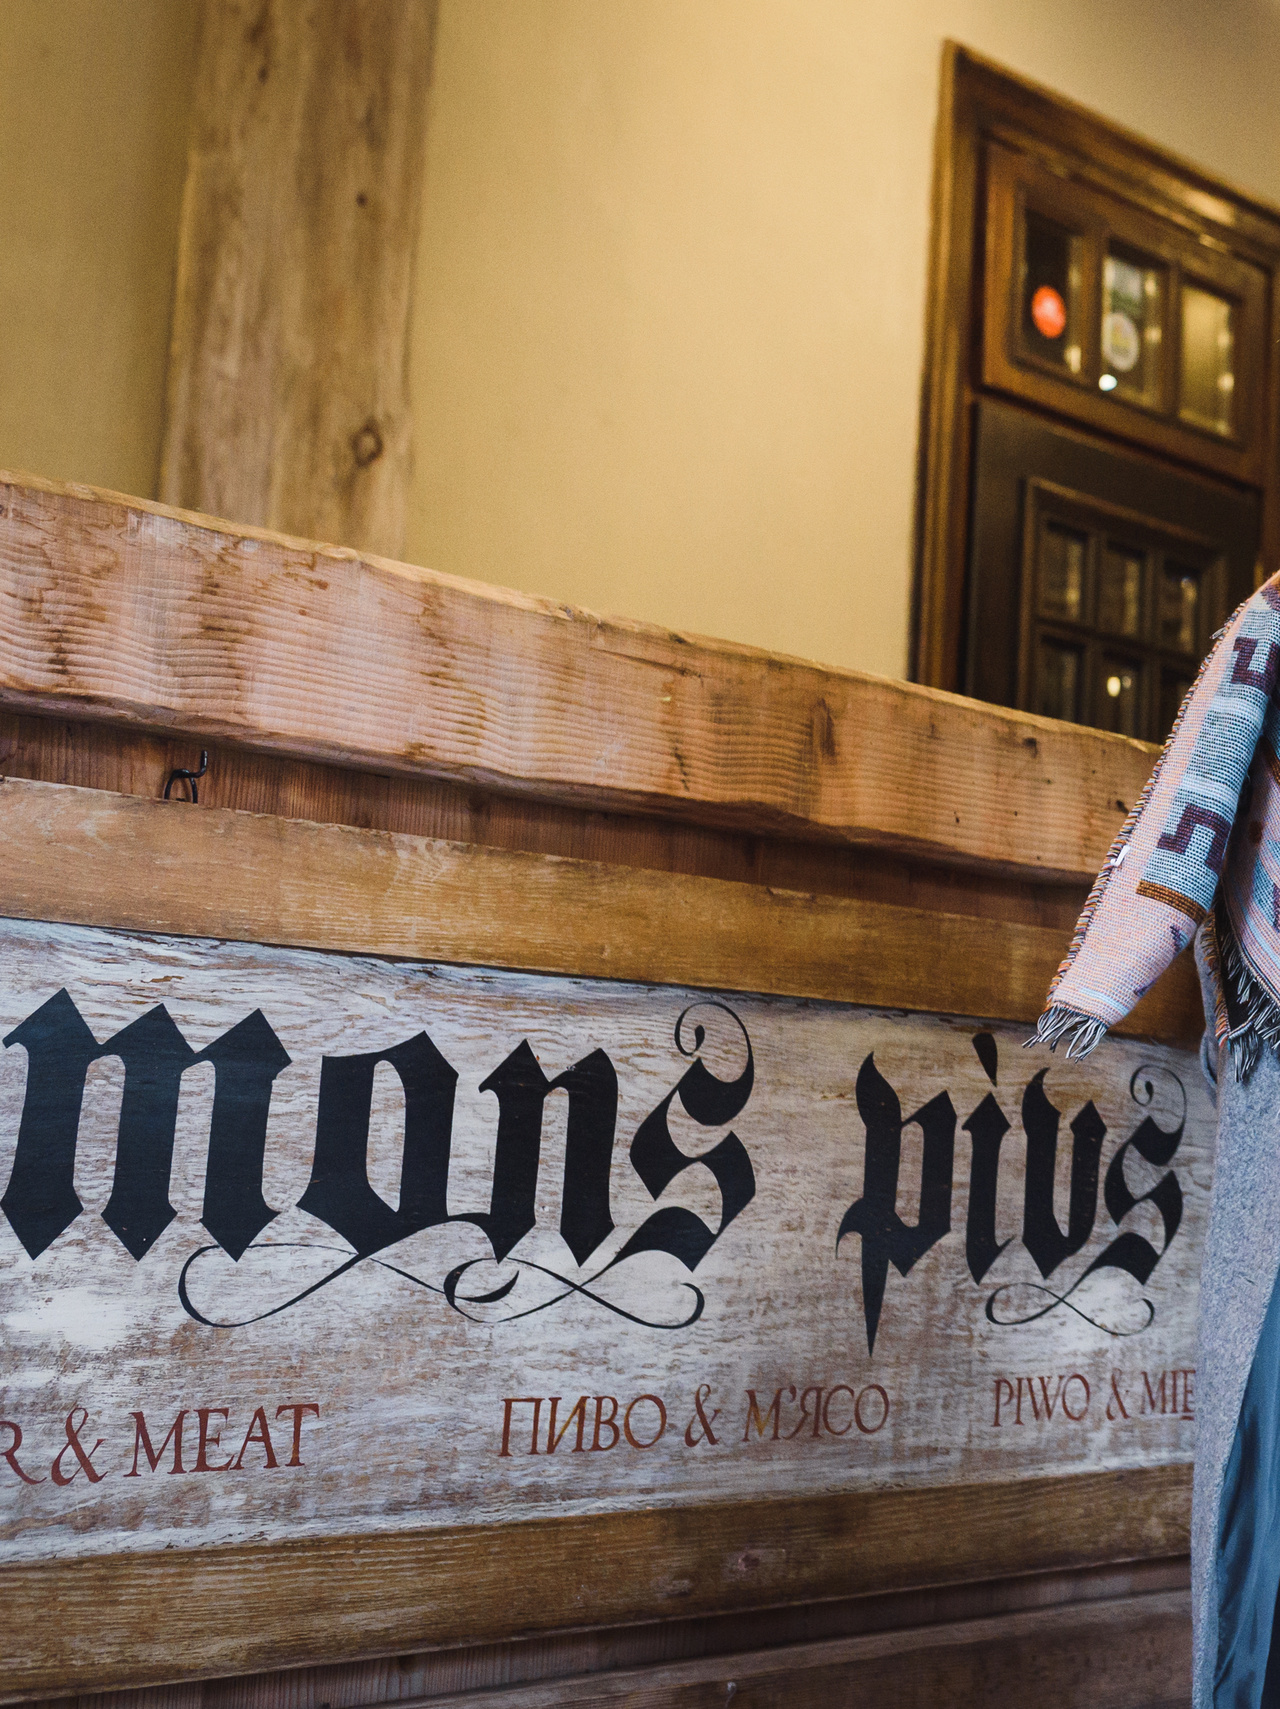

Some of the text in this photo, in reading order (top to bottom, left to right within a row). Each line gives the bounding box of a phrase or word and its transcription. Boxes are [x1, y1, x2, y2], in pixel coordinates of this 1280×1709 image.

[498, 1393, 668, 1457] ПИВО
[684, 1383, 721, 1447] &
[990, 1373, 1091, 1428] PIWO
[1106, 1367, 1131, 1421] &
[51, 1407, 108, 1486] &
[123, 1403, 320, 1478] MEAT
